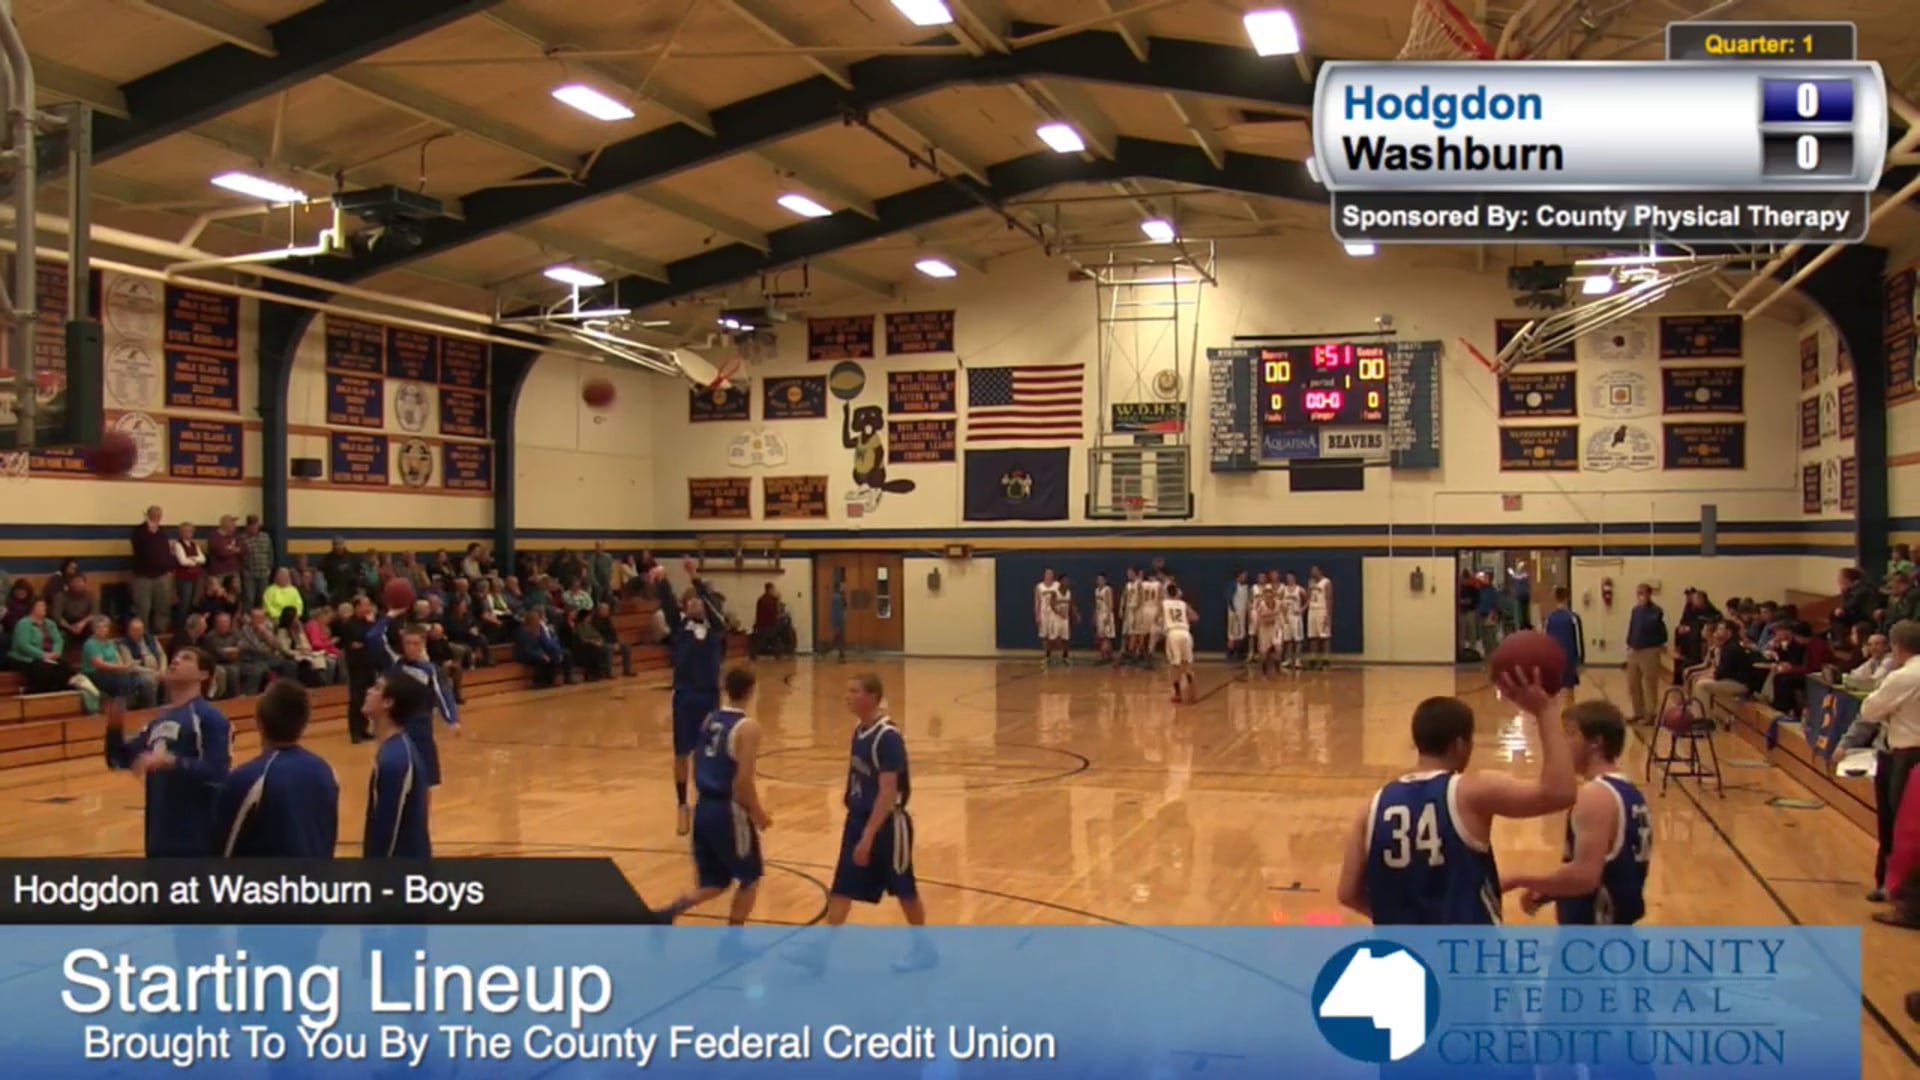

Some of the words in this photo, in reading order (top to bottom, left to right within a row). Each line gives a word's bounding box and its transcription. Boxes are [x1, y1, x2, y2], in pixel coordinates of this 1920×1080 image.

[1265, 361, 1290, 383] 00
[1358, 358, 1385, 380] 00
[1271, 393, 1282, 410] 0
[1368, 391, 1379, 408] 0
[1327, 434, 1383, 450] BEAVERS
[1383, 802, 1446, 869] 34
